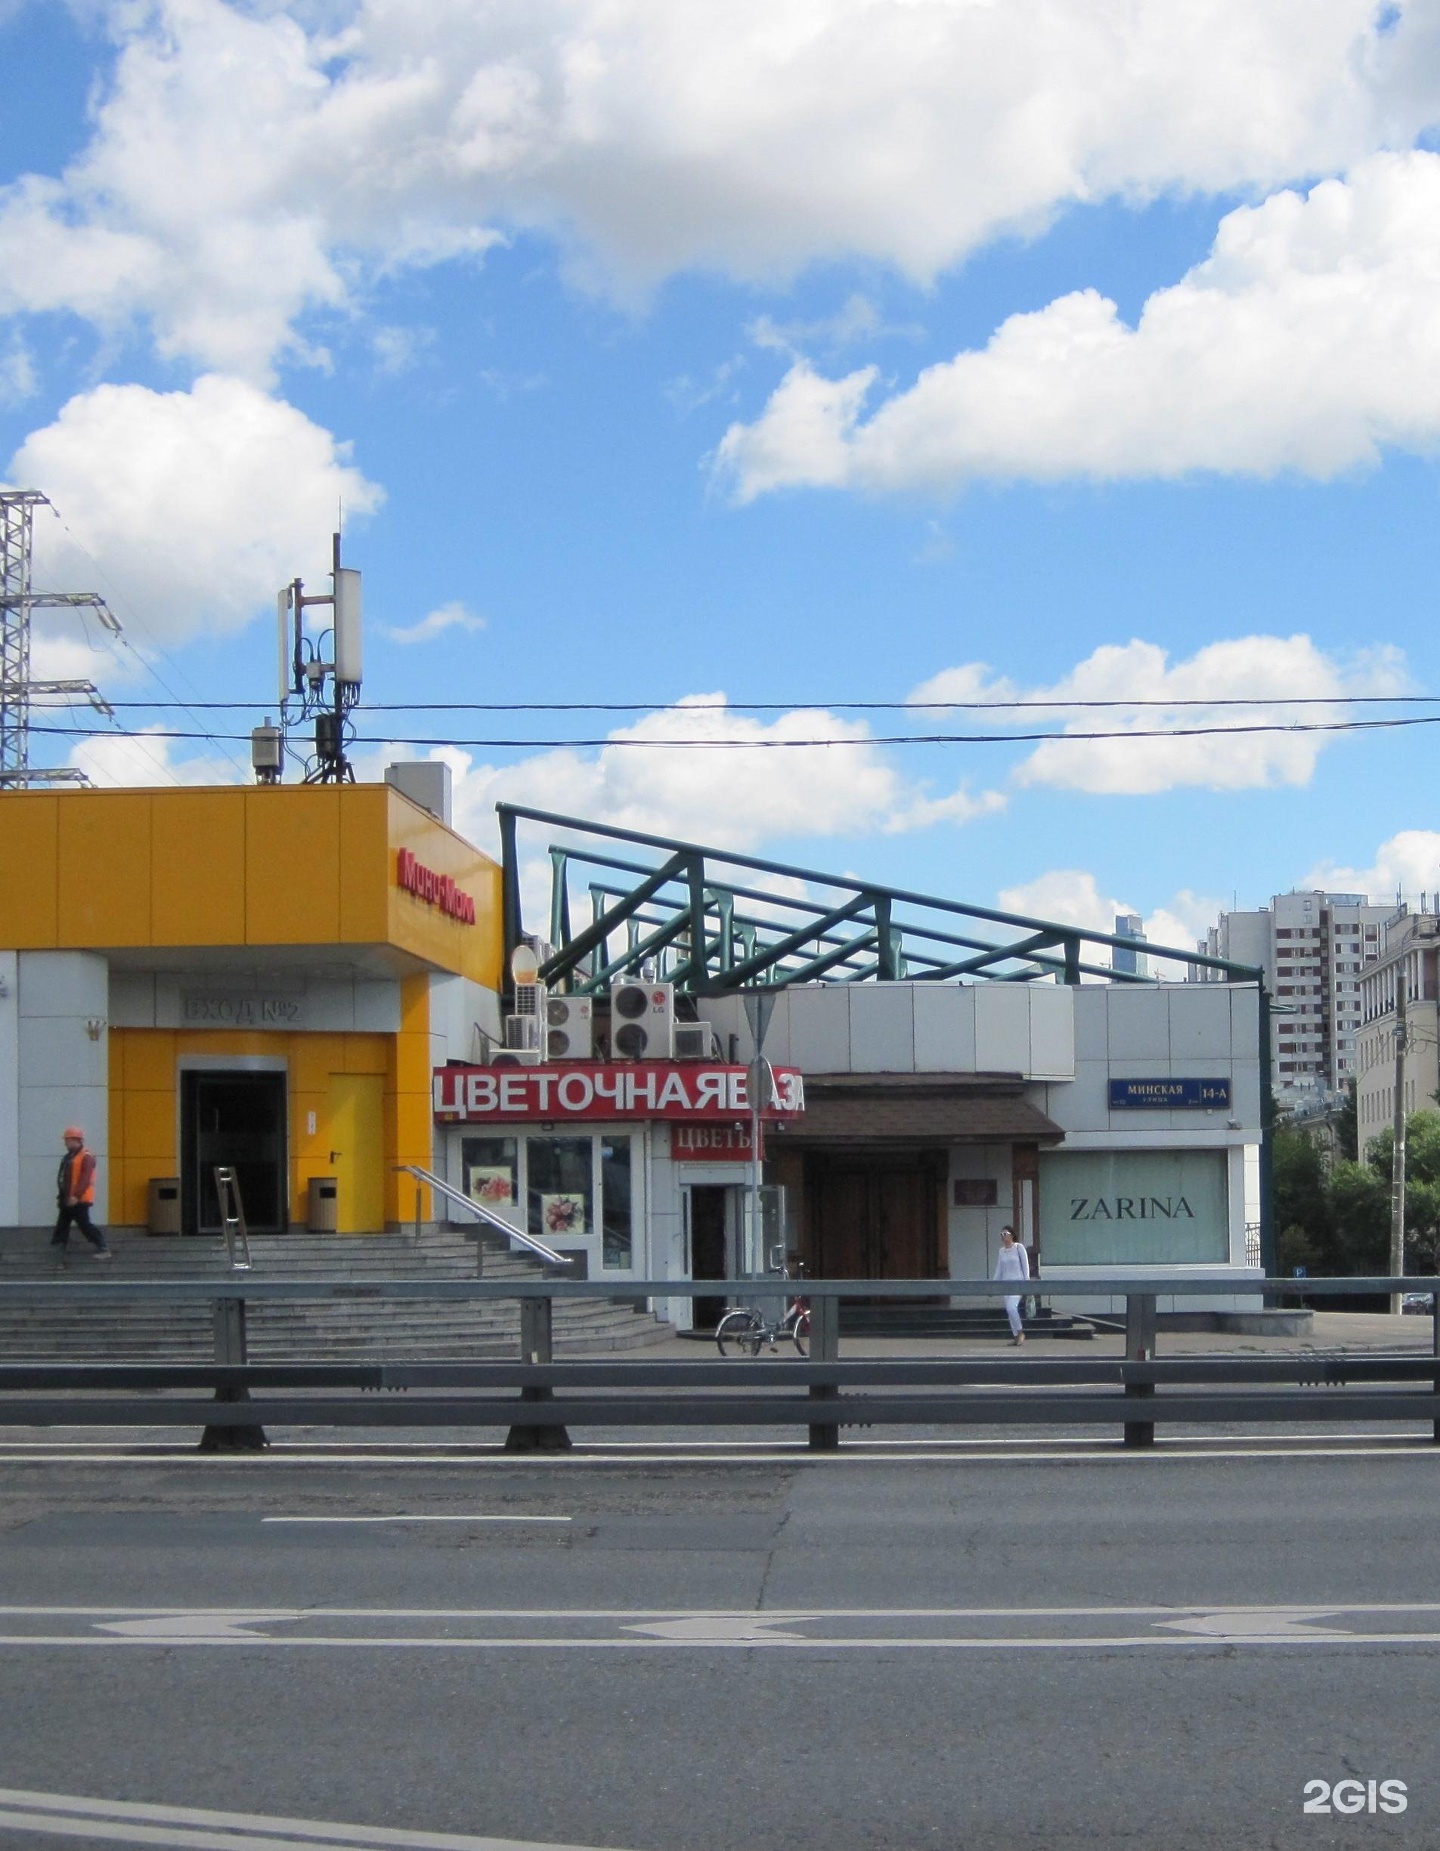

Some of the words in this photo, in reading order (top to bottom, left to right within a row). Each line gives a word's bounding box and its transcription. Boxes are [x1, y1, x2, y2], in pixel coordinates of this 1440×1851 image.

[185, 1000, 254, 1024] ВХОД
[652, 1006, 664, 1014] LG
[1127, 1085, 1183, 1095] МИНСКАЯ
[1070, 1197, 1195, 1220] ZARINA
